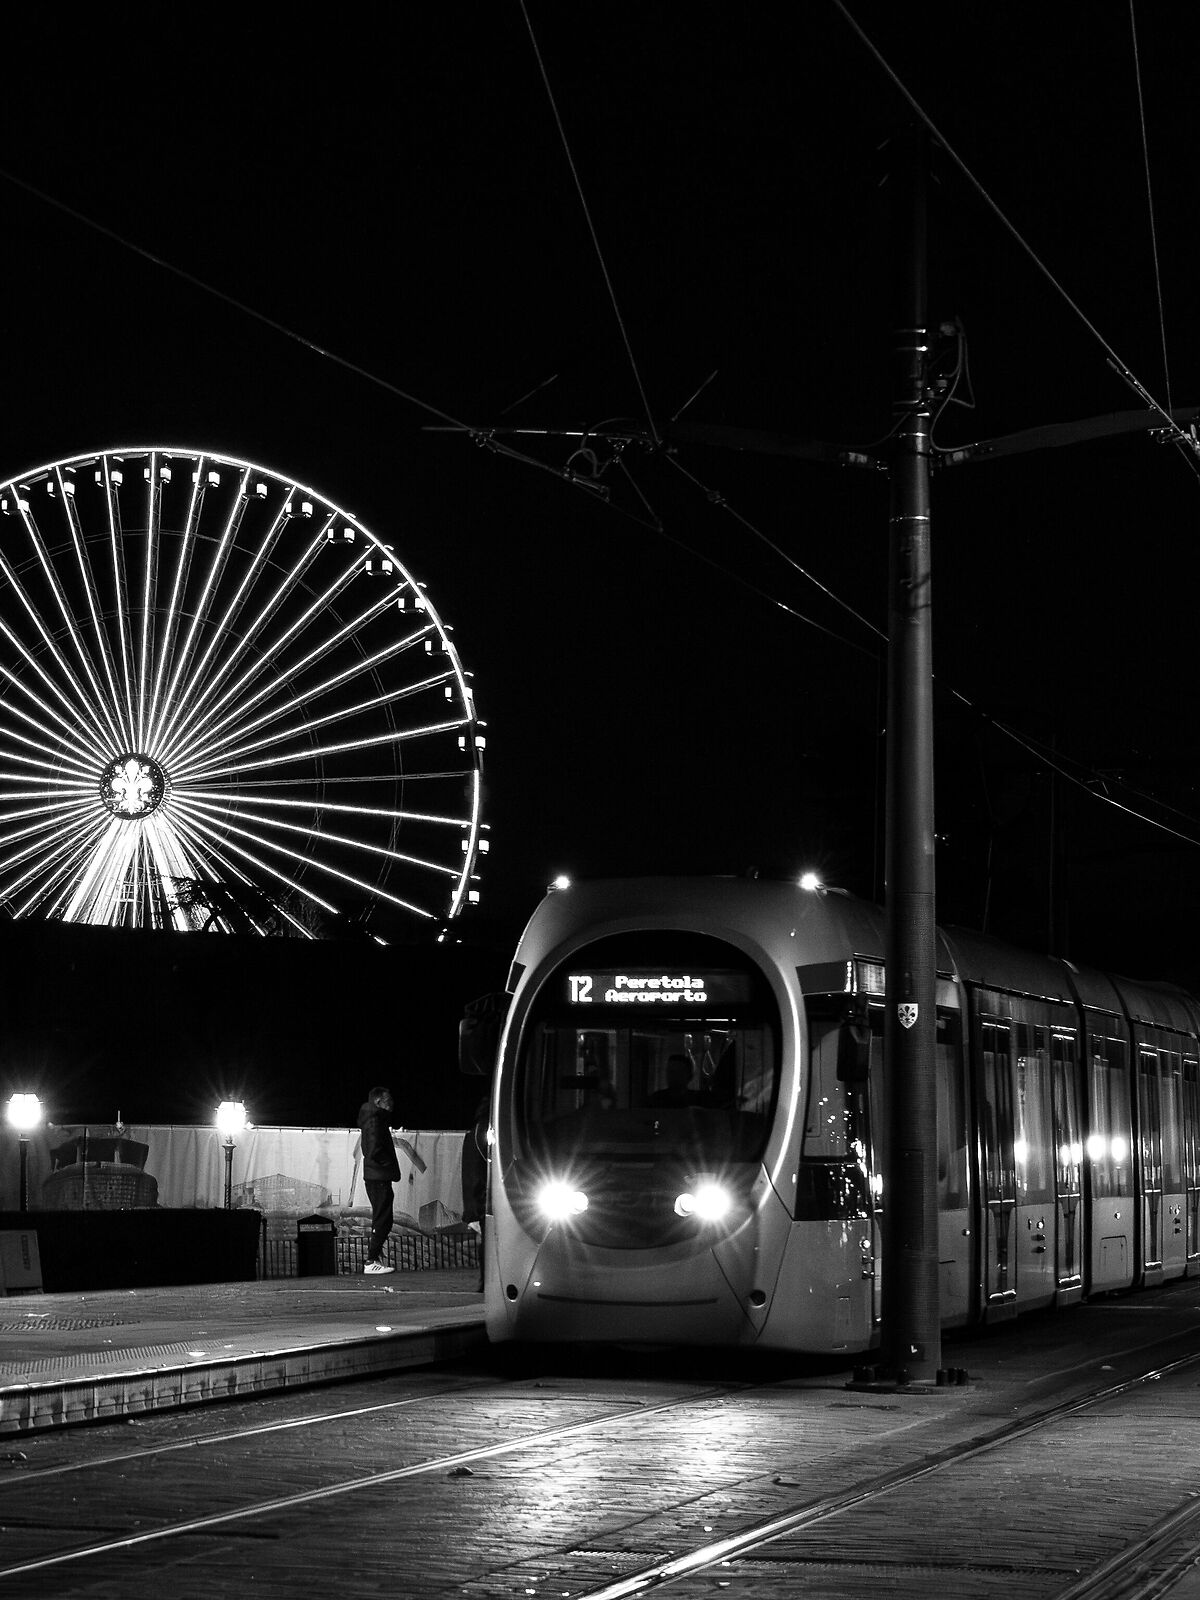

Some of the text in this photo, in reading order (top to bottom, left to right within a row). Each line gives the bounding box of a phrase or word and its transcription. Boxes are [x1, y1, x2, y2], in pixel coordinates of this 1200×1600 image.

[568, 975, 593, 1002] T2
[615, 975, 704, 989] Peretola
[604, 989, 707, 1002] Aeroporto
